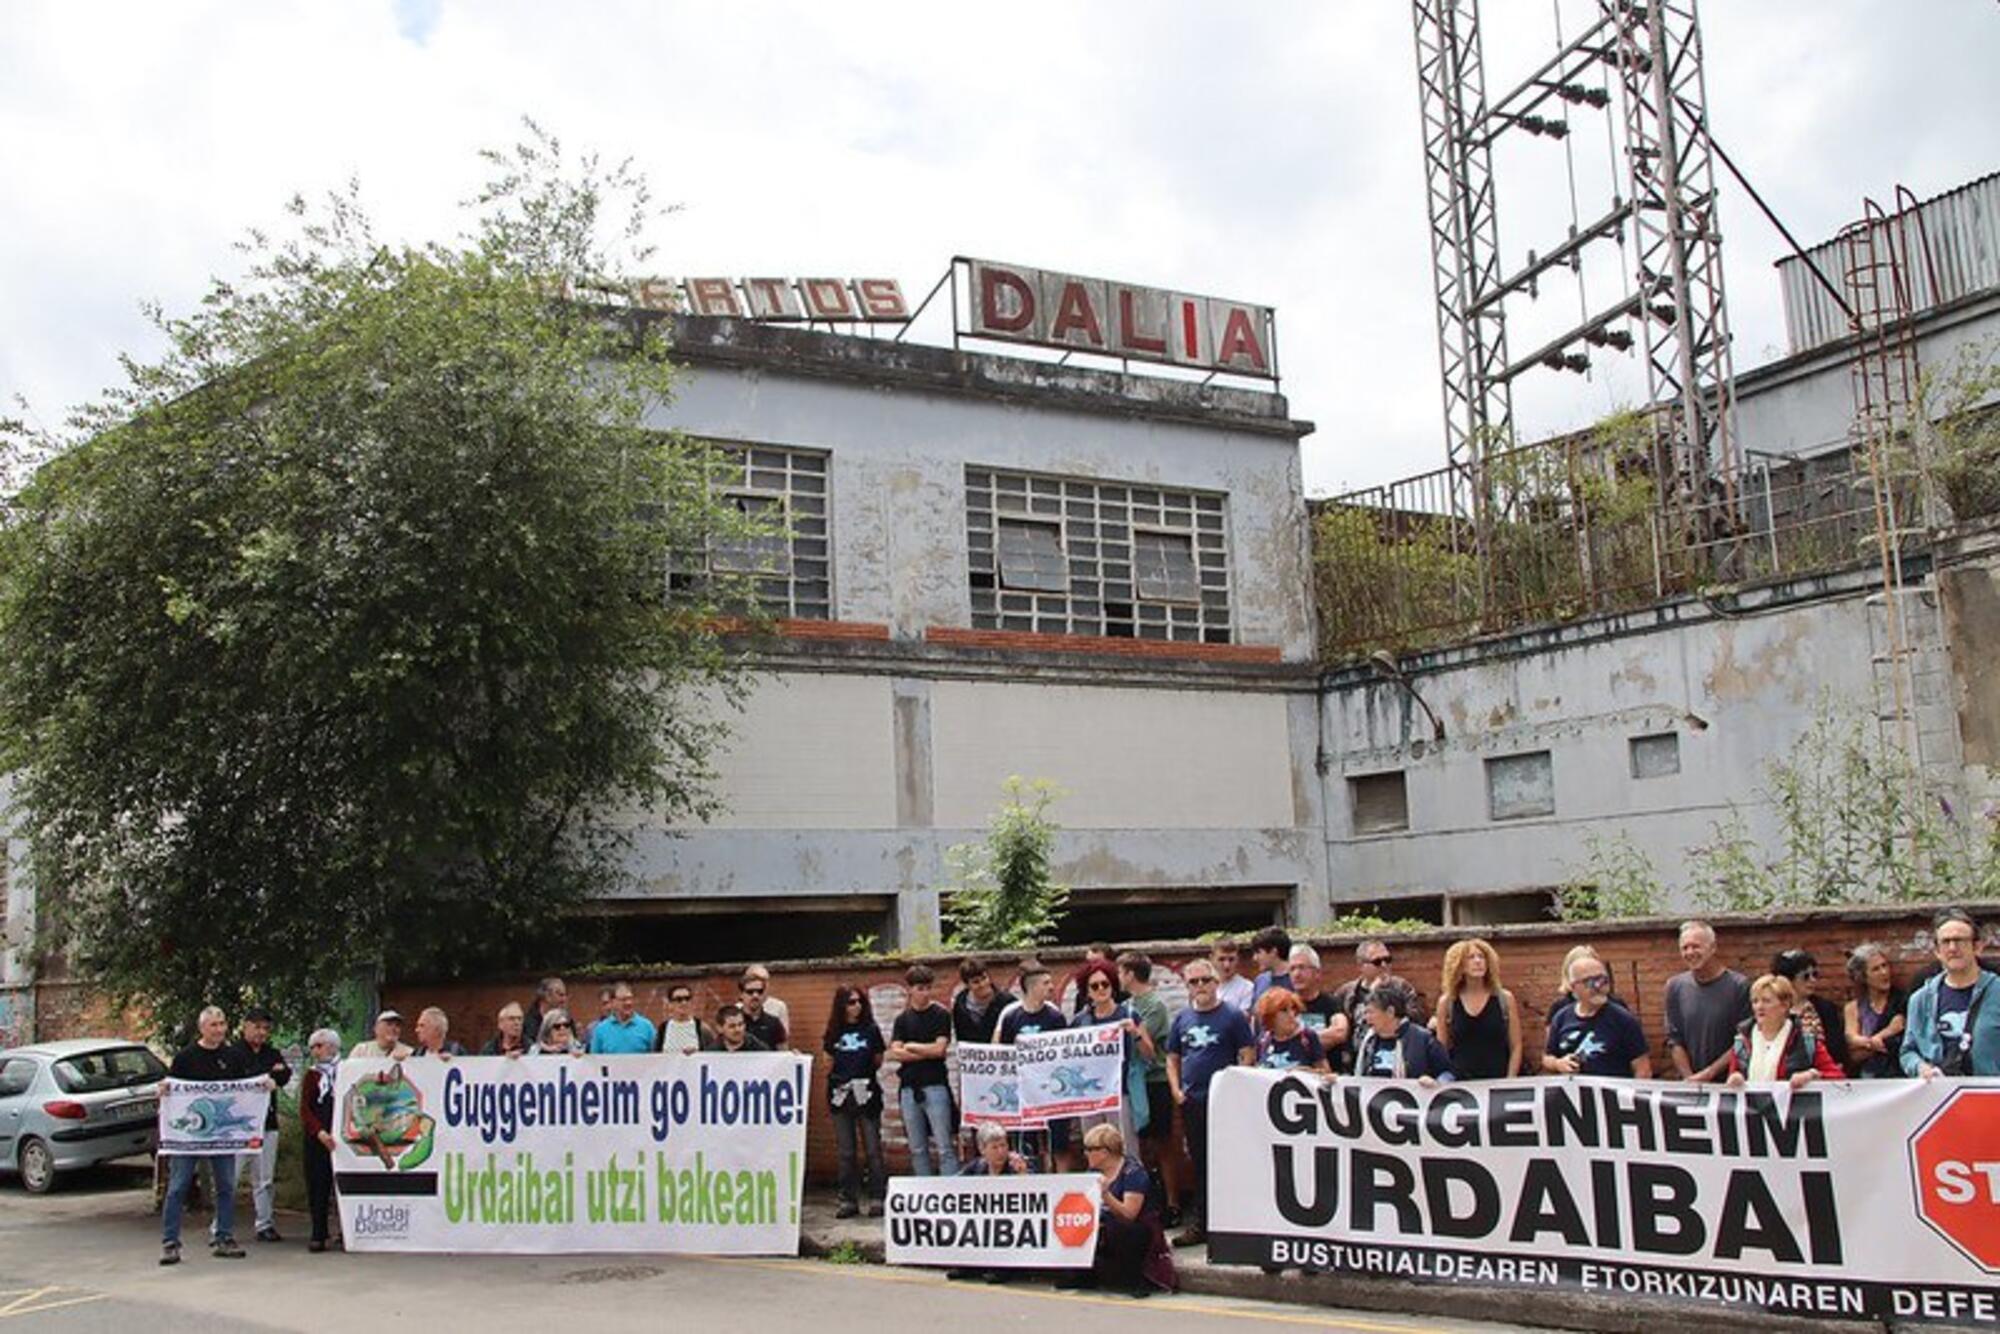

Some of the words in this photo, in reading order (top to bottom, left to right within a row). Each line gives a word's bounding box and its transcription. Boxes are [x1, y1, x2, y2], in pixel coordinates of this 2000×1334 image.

[980, 266, 1267, 369] DALIA
[444, 1066, 640, 1143] Guggenheim
[652, 1078, 690, 1142] go
[700, 1064, 804, 1125] home!
[1267, 1075, 1829, 1160] GUGGENHEIM
[444, 1152, 575, 1226] Urdaibai
[586, 1152, 646, 1225] utzi
[657, 1151, 778, 1226] bakean
[889, 1192, 1048, 1215] GUGGENHEIM
[1055, 1211, 1093, 1228] STOP
[1272, 1143, 1844, 1266] URDAIBAI
[890, 1217, 1048, 1248] URDAIBAI
[1271, 1240, 1559, 1286] BUSTURIALDEAREN
[1581, 1266, 1864, 1314] ETORKIZUNAREN
